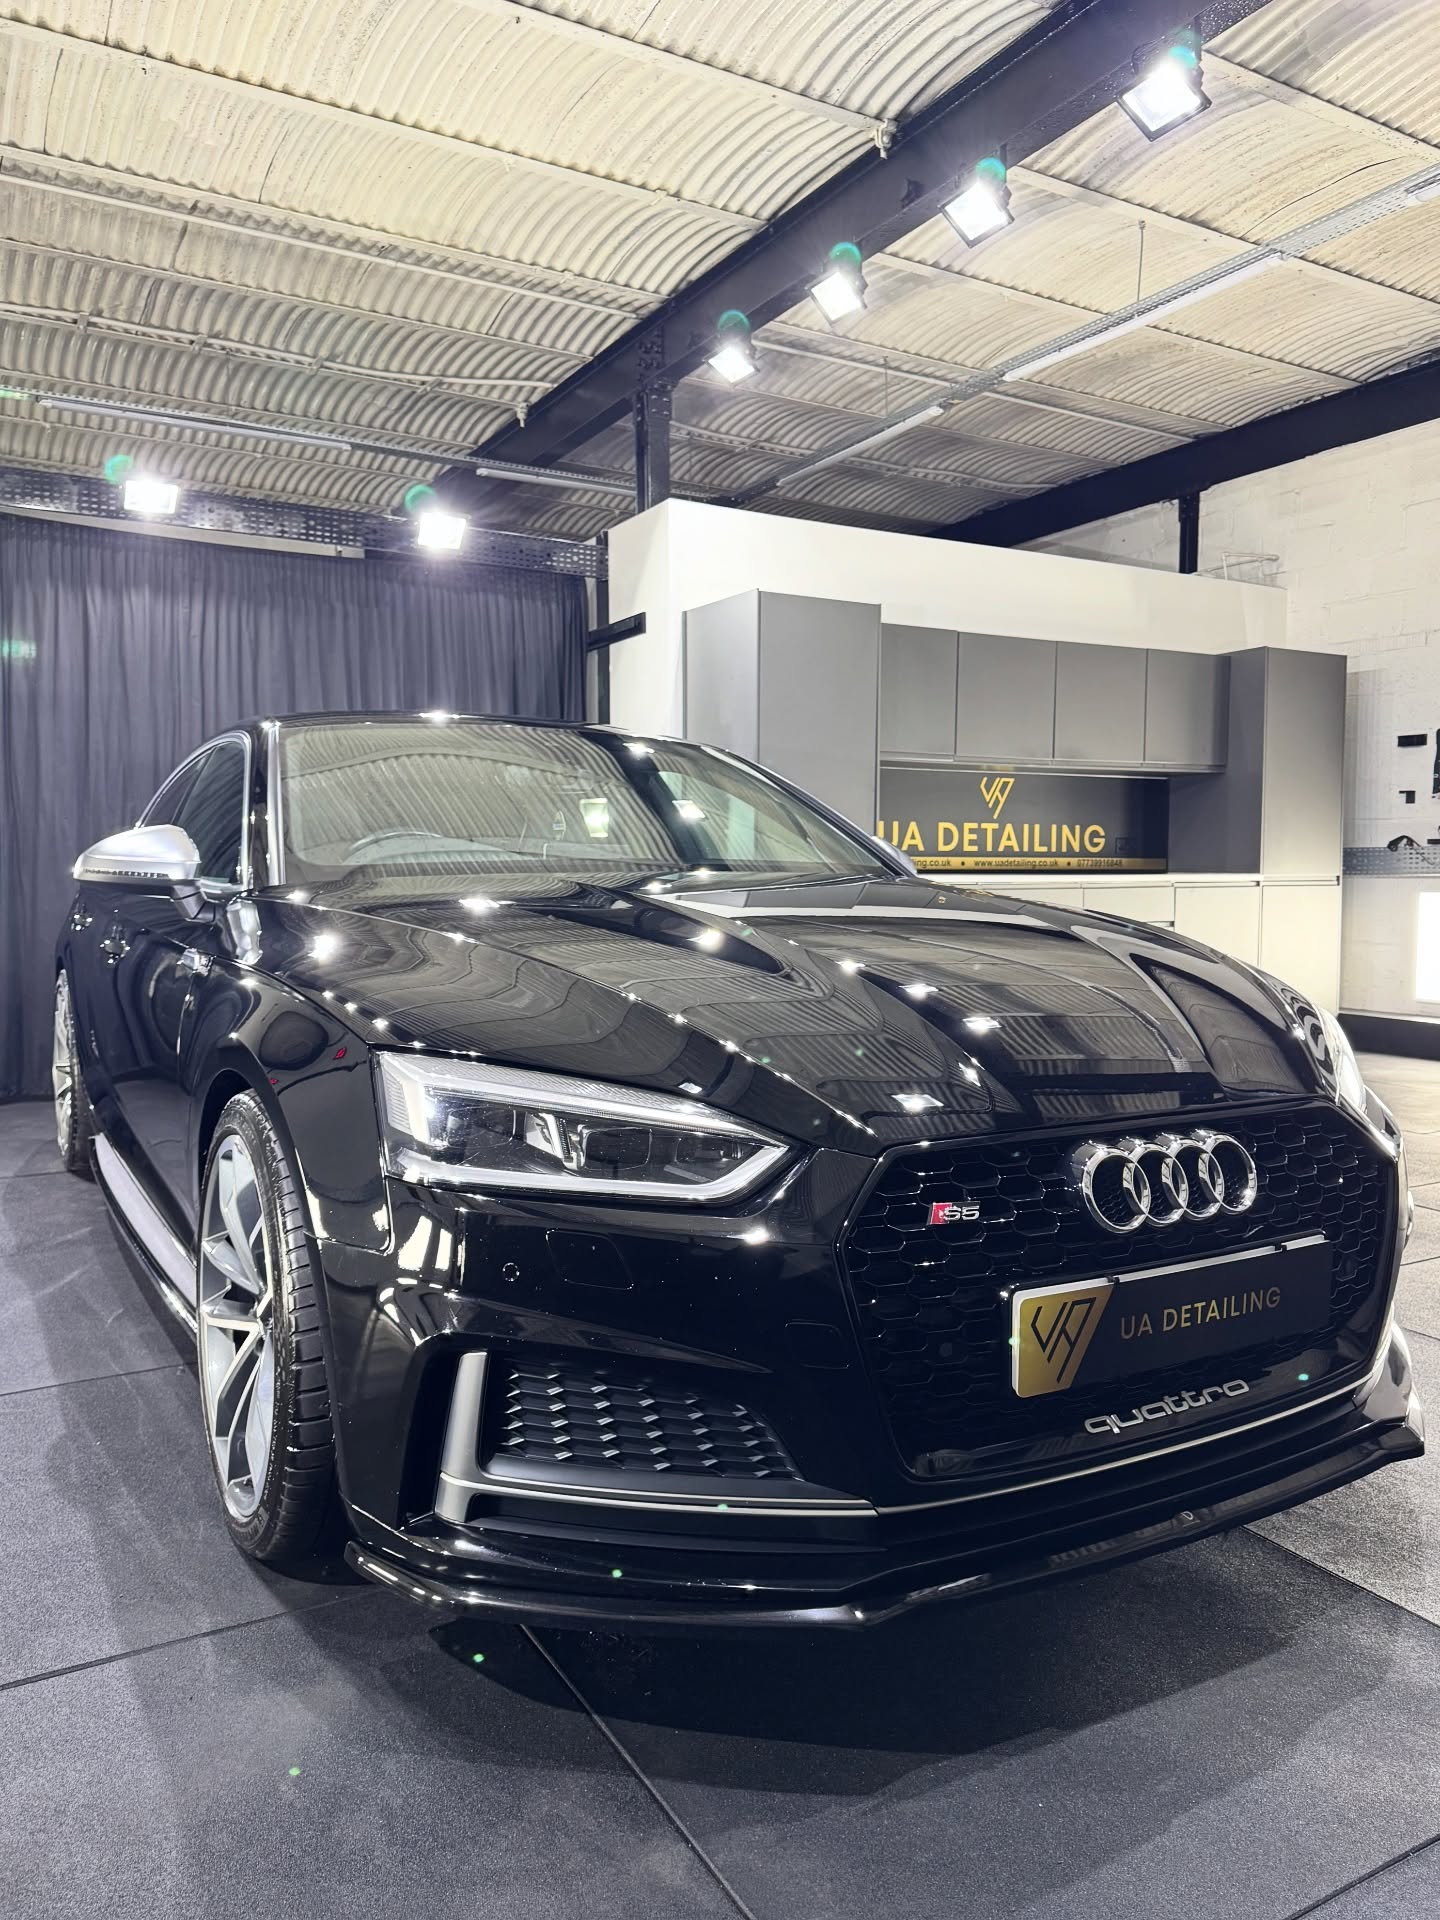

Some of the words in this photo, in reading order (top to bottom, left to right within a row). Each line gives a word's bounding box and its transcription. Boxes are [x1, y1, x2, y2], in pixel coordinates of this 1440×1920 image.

[878, 820, 925, 851] UA
[937, 821, 1106, 853] DETAILING
[944, 1205, 980, 1220] S5
[1120, 1313, 1153, 1339] UA
[1162, 1286, 1281, 1332] DETAILING
[1084, 1379, 1249, 1434] quattro
